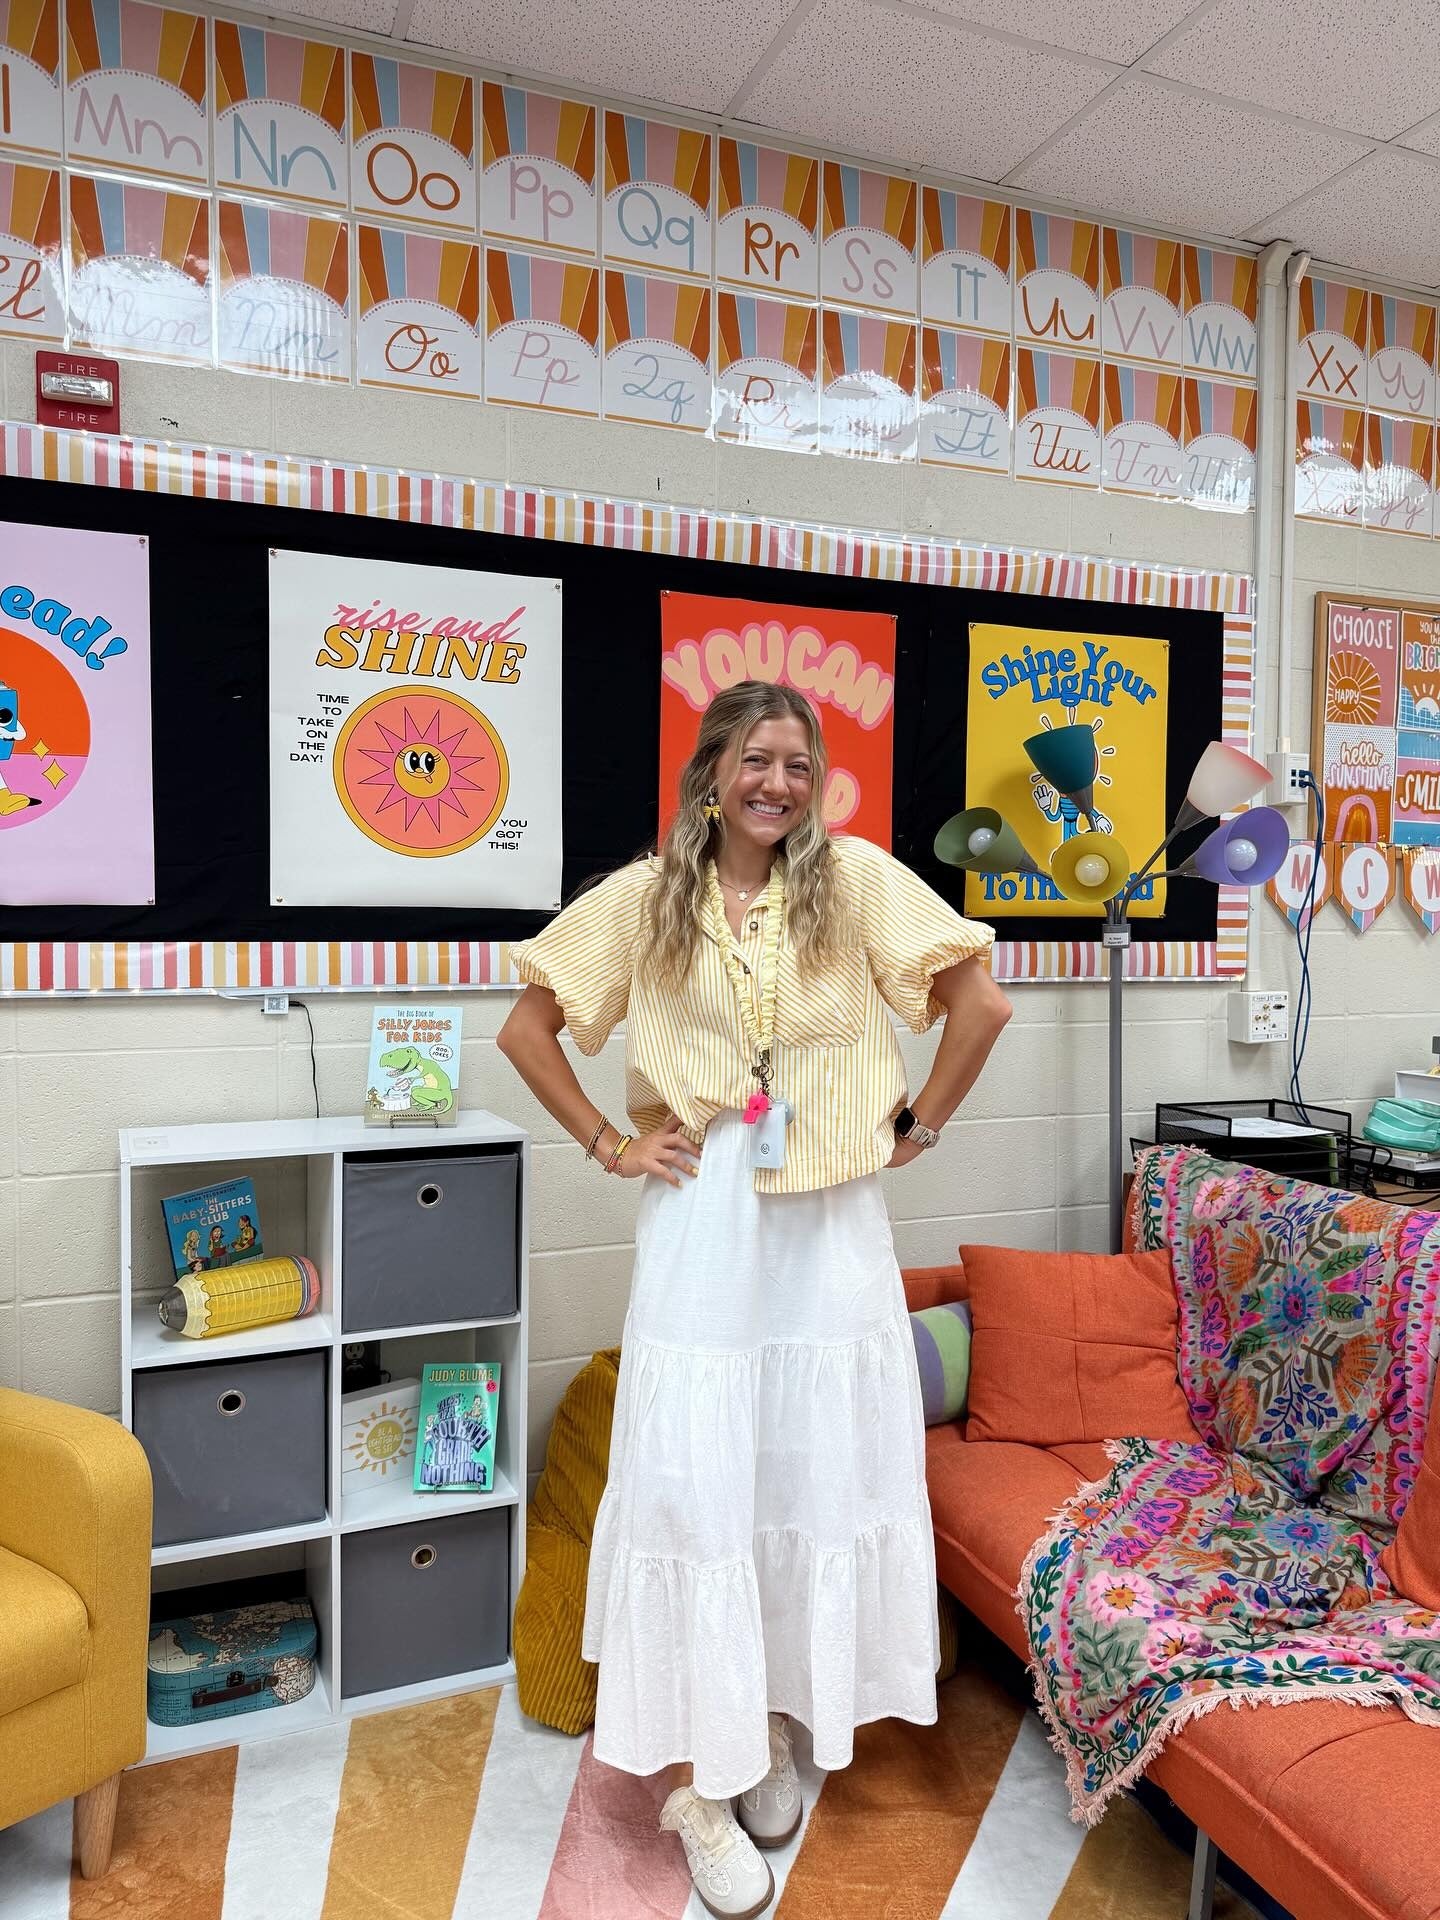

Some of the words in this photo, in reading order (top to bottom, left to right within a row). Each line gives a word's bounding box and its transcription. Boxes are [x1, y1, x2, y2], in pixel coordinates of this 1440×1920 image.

[74, 88, 203, 166] Mm
[233, 114, 337, 190] Nn
[367, 142, 461, 211] Oo
[510, 161, 574, 241] Pp
[617, 188, 695, 271] Qq
[744, 218, 800, 281] Rr
[842, 238, 898, 299] Ss
[951, 263, 987, 320] Tt
[1022, 286, 1095, 341] Uu
[1111, 300, 1175, 359] Vv
[1189, 317, 1255, 372] Ww
[1307, 340, 1358, 397] Xx
[1378, 358, 1425, 412] Yy
[57, 362, 98, 377] FIRE
[385, 324, 459, 377] Oo
[513, 331, 580, 404] Pp
[58, 411, 99, 425] FIRE
[332, 599, 432, 633] rise
[431, 605, 527, 643] and
[1333, 613, 1393, 650] CHOOSE
[315, 624, 527, 684] SHINE
[662, 622, 786, 711] YOU
[786, 626, 895, 730] CAN
[981, 645, 1076, 699] Shine
[1082, 641, 1156, 705] Your
[1027, 664, 1113, 707] Light
[316, 693, 350, 704] TIME
[1335, 688, 1361, 705] HAPPY
[322, 706, 342, 716] TO
[297, 716, 334, 728] TAKE
[306, 729, 328, 739] ON
[297, 741, 326, 751] THE
[1341, 741, 1383, 766] hello
[289, 753, 323, 763] DAY!
[1327, 763, 1391, 792] SUNSHINE
[500, 818, 528, 828] YOU
[495, 830, 524, 839] GOT
[488, 841, 519, 850] THIS!
[980, 872, 1017, 901] To
[1019, 872, 1068, 901] Th
[386, 1031, 410, 1043] FOR
[173, 1194, 252, 1224] BABY-SITTERS
[205, 1197, 219, 1205] THE
[200, 1211, 229, 1226] CLUB
[429, 1369, 455, 1382] JUDY
[459, 1368, 493, 1381] BLUME
[431, 1417, 491, 1452] FOURTH
[437, 1438, 474, 1465] GRADE
[421, 1462, 486, 1486] NOTHING
